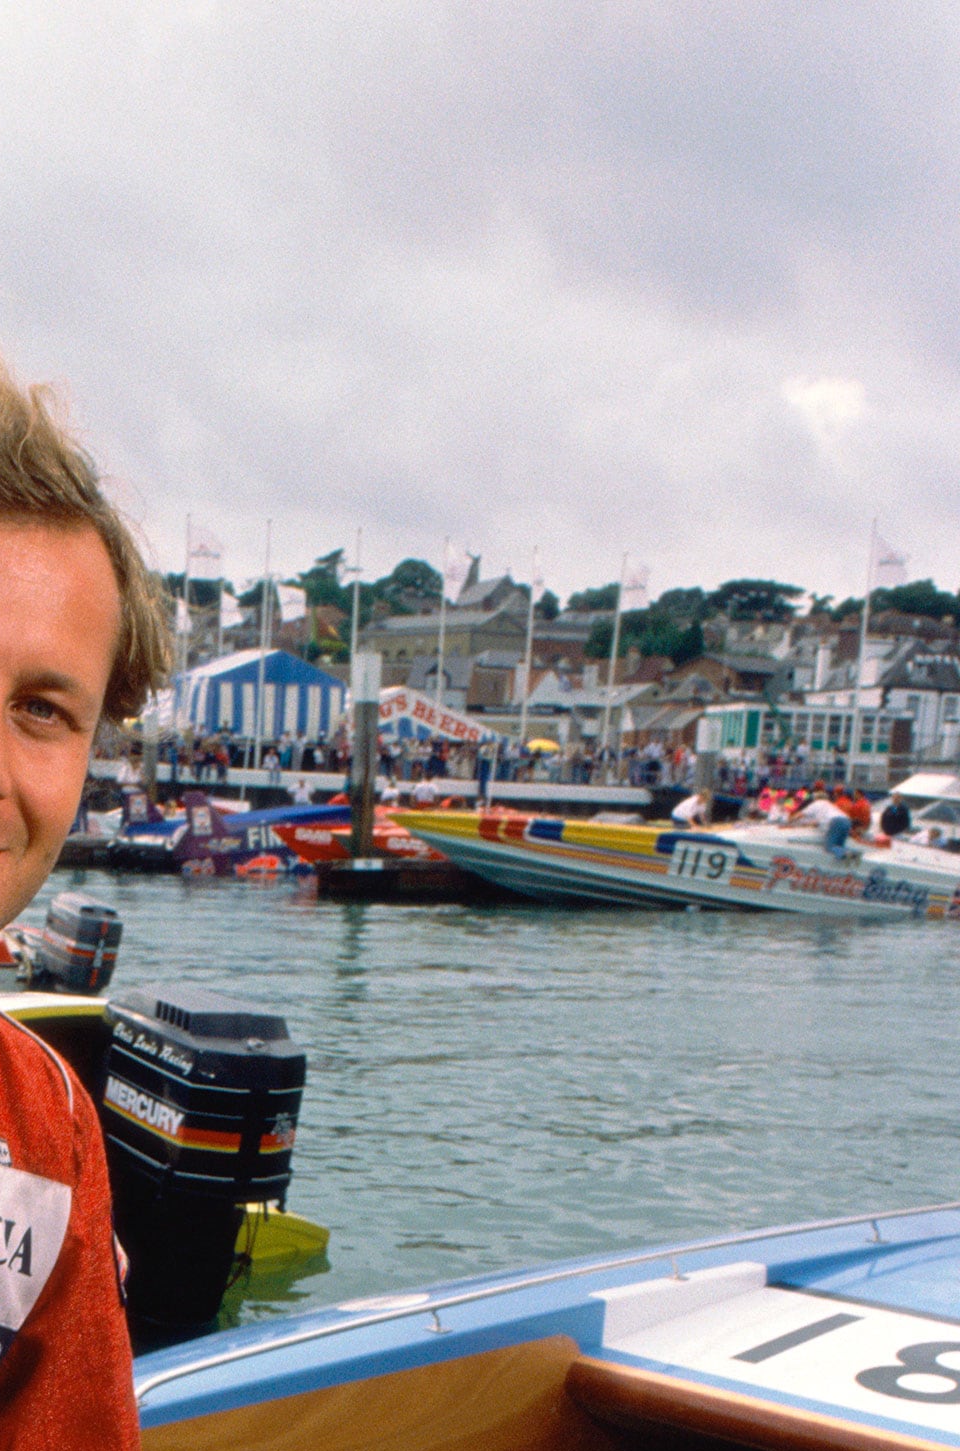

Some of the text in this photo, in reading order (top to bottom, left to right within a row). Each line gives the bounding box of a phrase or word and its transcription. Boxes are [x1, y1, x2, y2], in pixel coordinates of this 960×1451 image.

[413, 700, 481, 742] BEERS
[677, 847, 727, 880] 119
[157, 1043, 194, 1076] Racing
[104, 1076, 185, 1136] MERCURY
[730, 1312, 960, 1405] 18
